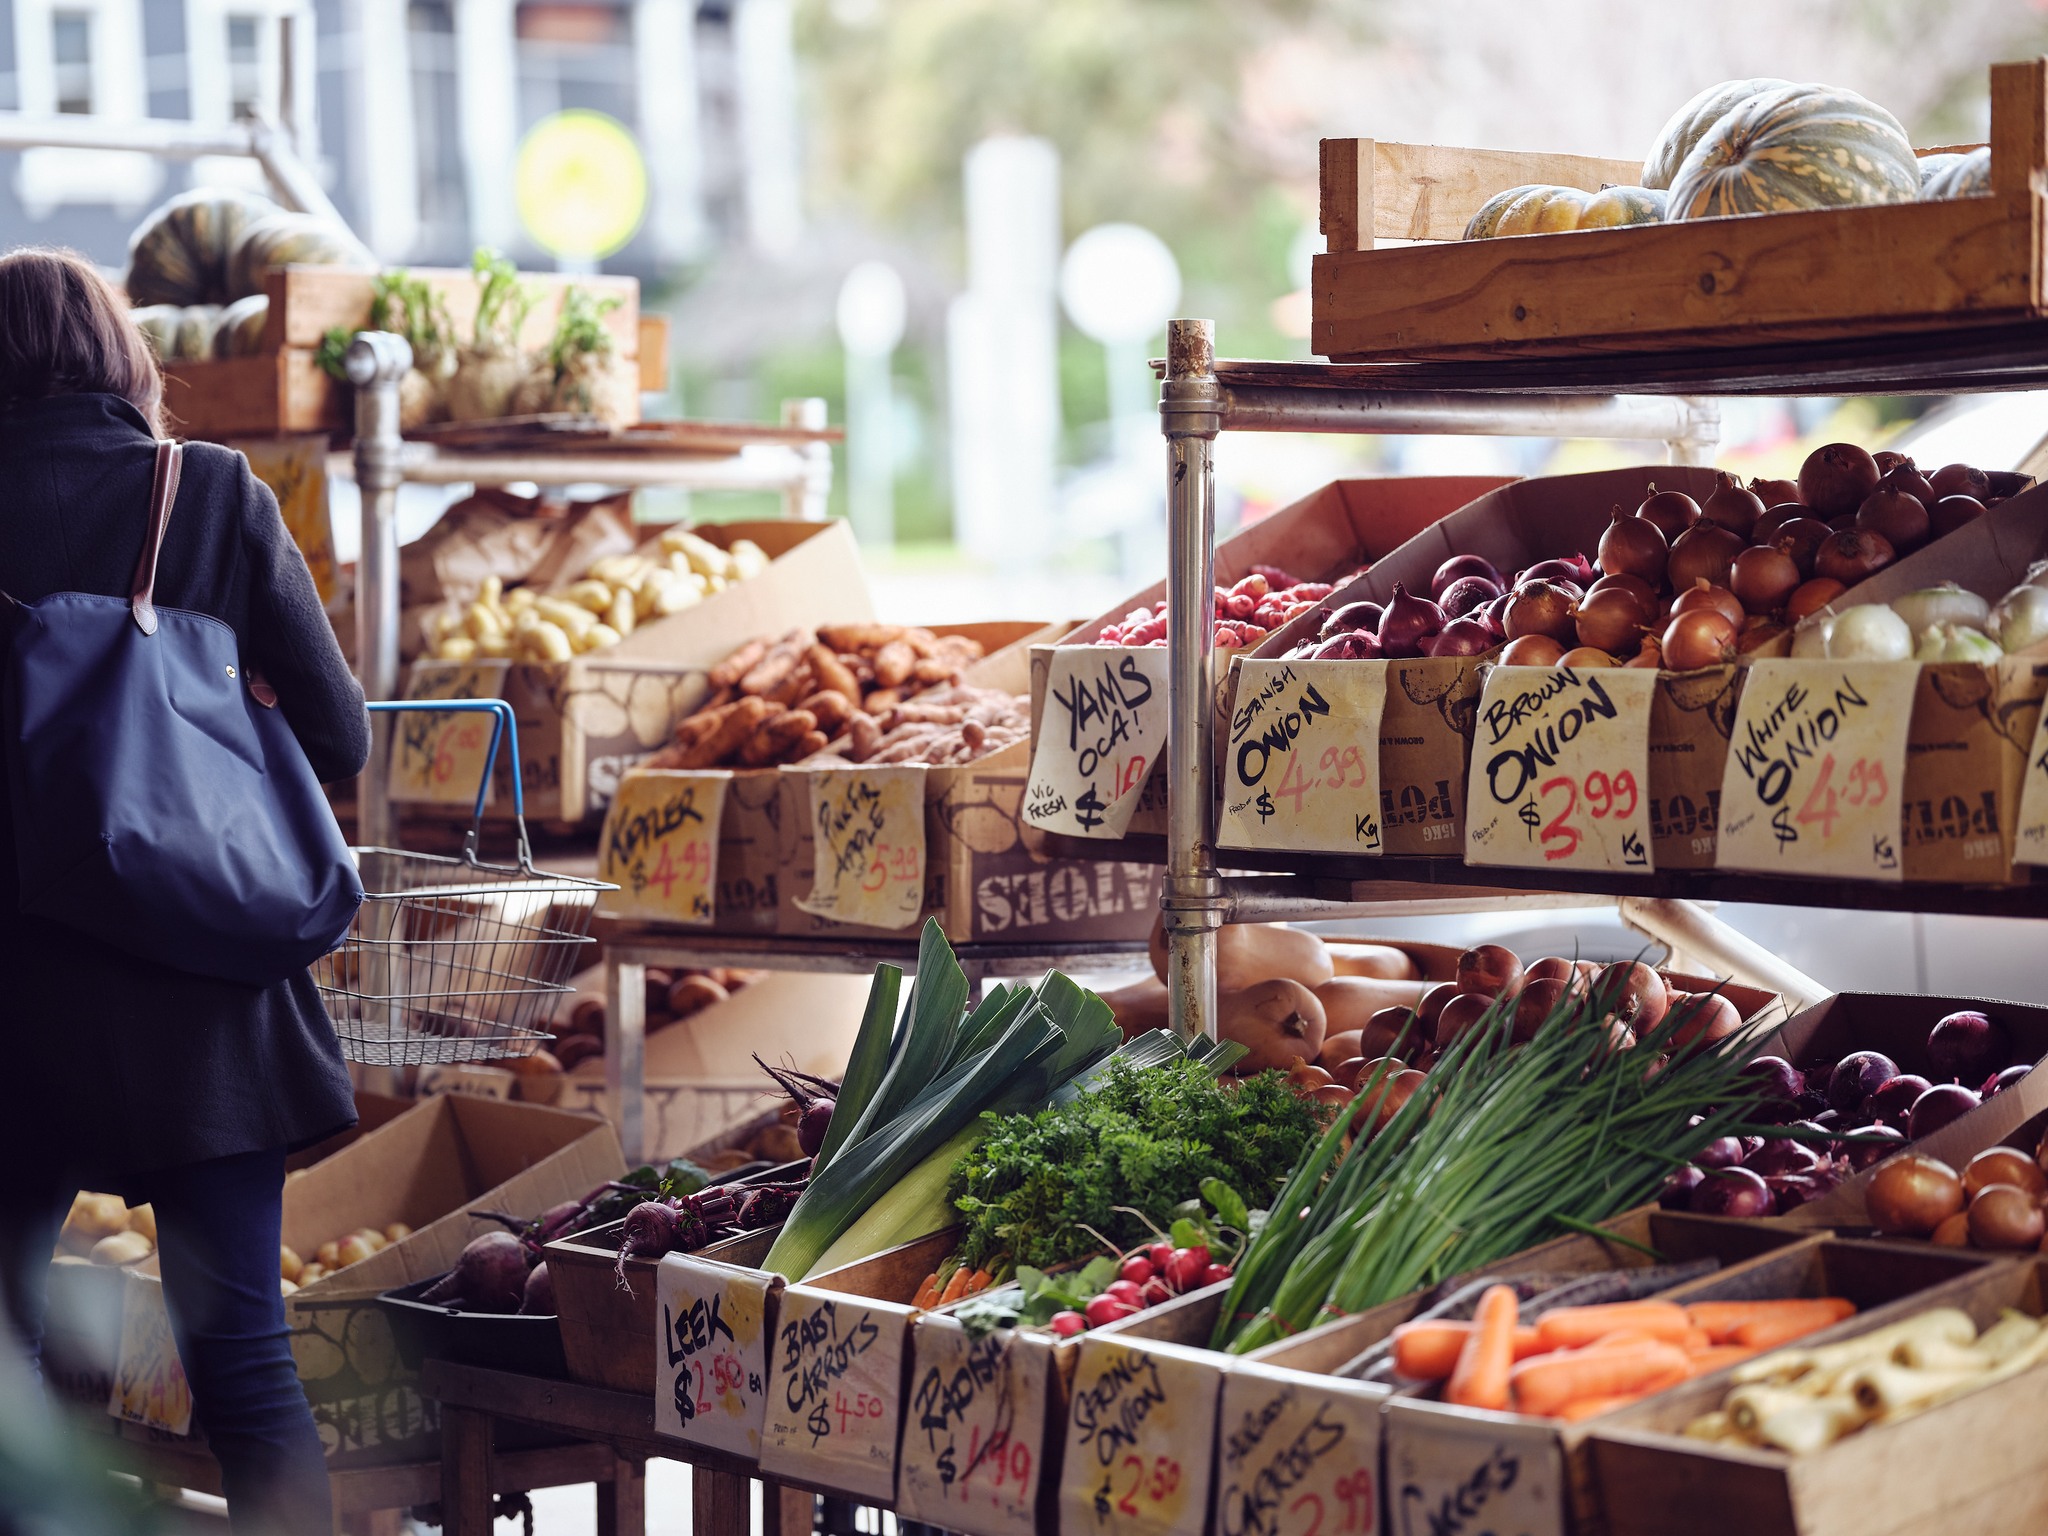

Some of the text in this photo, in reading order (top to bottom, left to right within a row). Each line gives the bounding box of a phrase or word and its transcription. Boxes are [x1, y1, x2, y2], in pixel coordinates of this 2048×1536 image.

[1053, 656, 1151, 752] YAMS
[1483, 666, 1582, 746] BROWN
[1735, 682, 1808, 780] WHITE
[1027, 795, 1068, 820] FRESH
[1256, 785, 1276, 825] $
[1274, 746, 1367, 815] 4.99
[1519, 792, 1541, 843] $
[1772, 753, 1890, 855] $ 4.99
[1423, 822, 1456, 843] 15KG
[665, 1293, 735, 1368] LEEK
[781, 1300, 838, 1373] BABY
[786, 1311, 879, 1414] CARROTS
[674, 1353, 745, 1428] $ 2.50
[807, 1398, 831, 1448] $
